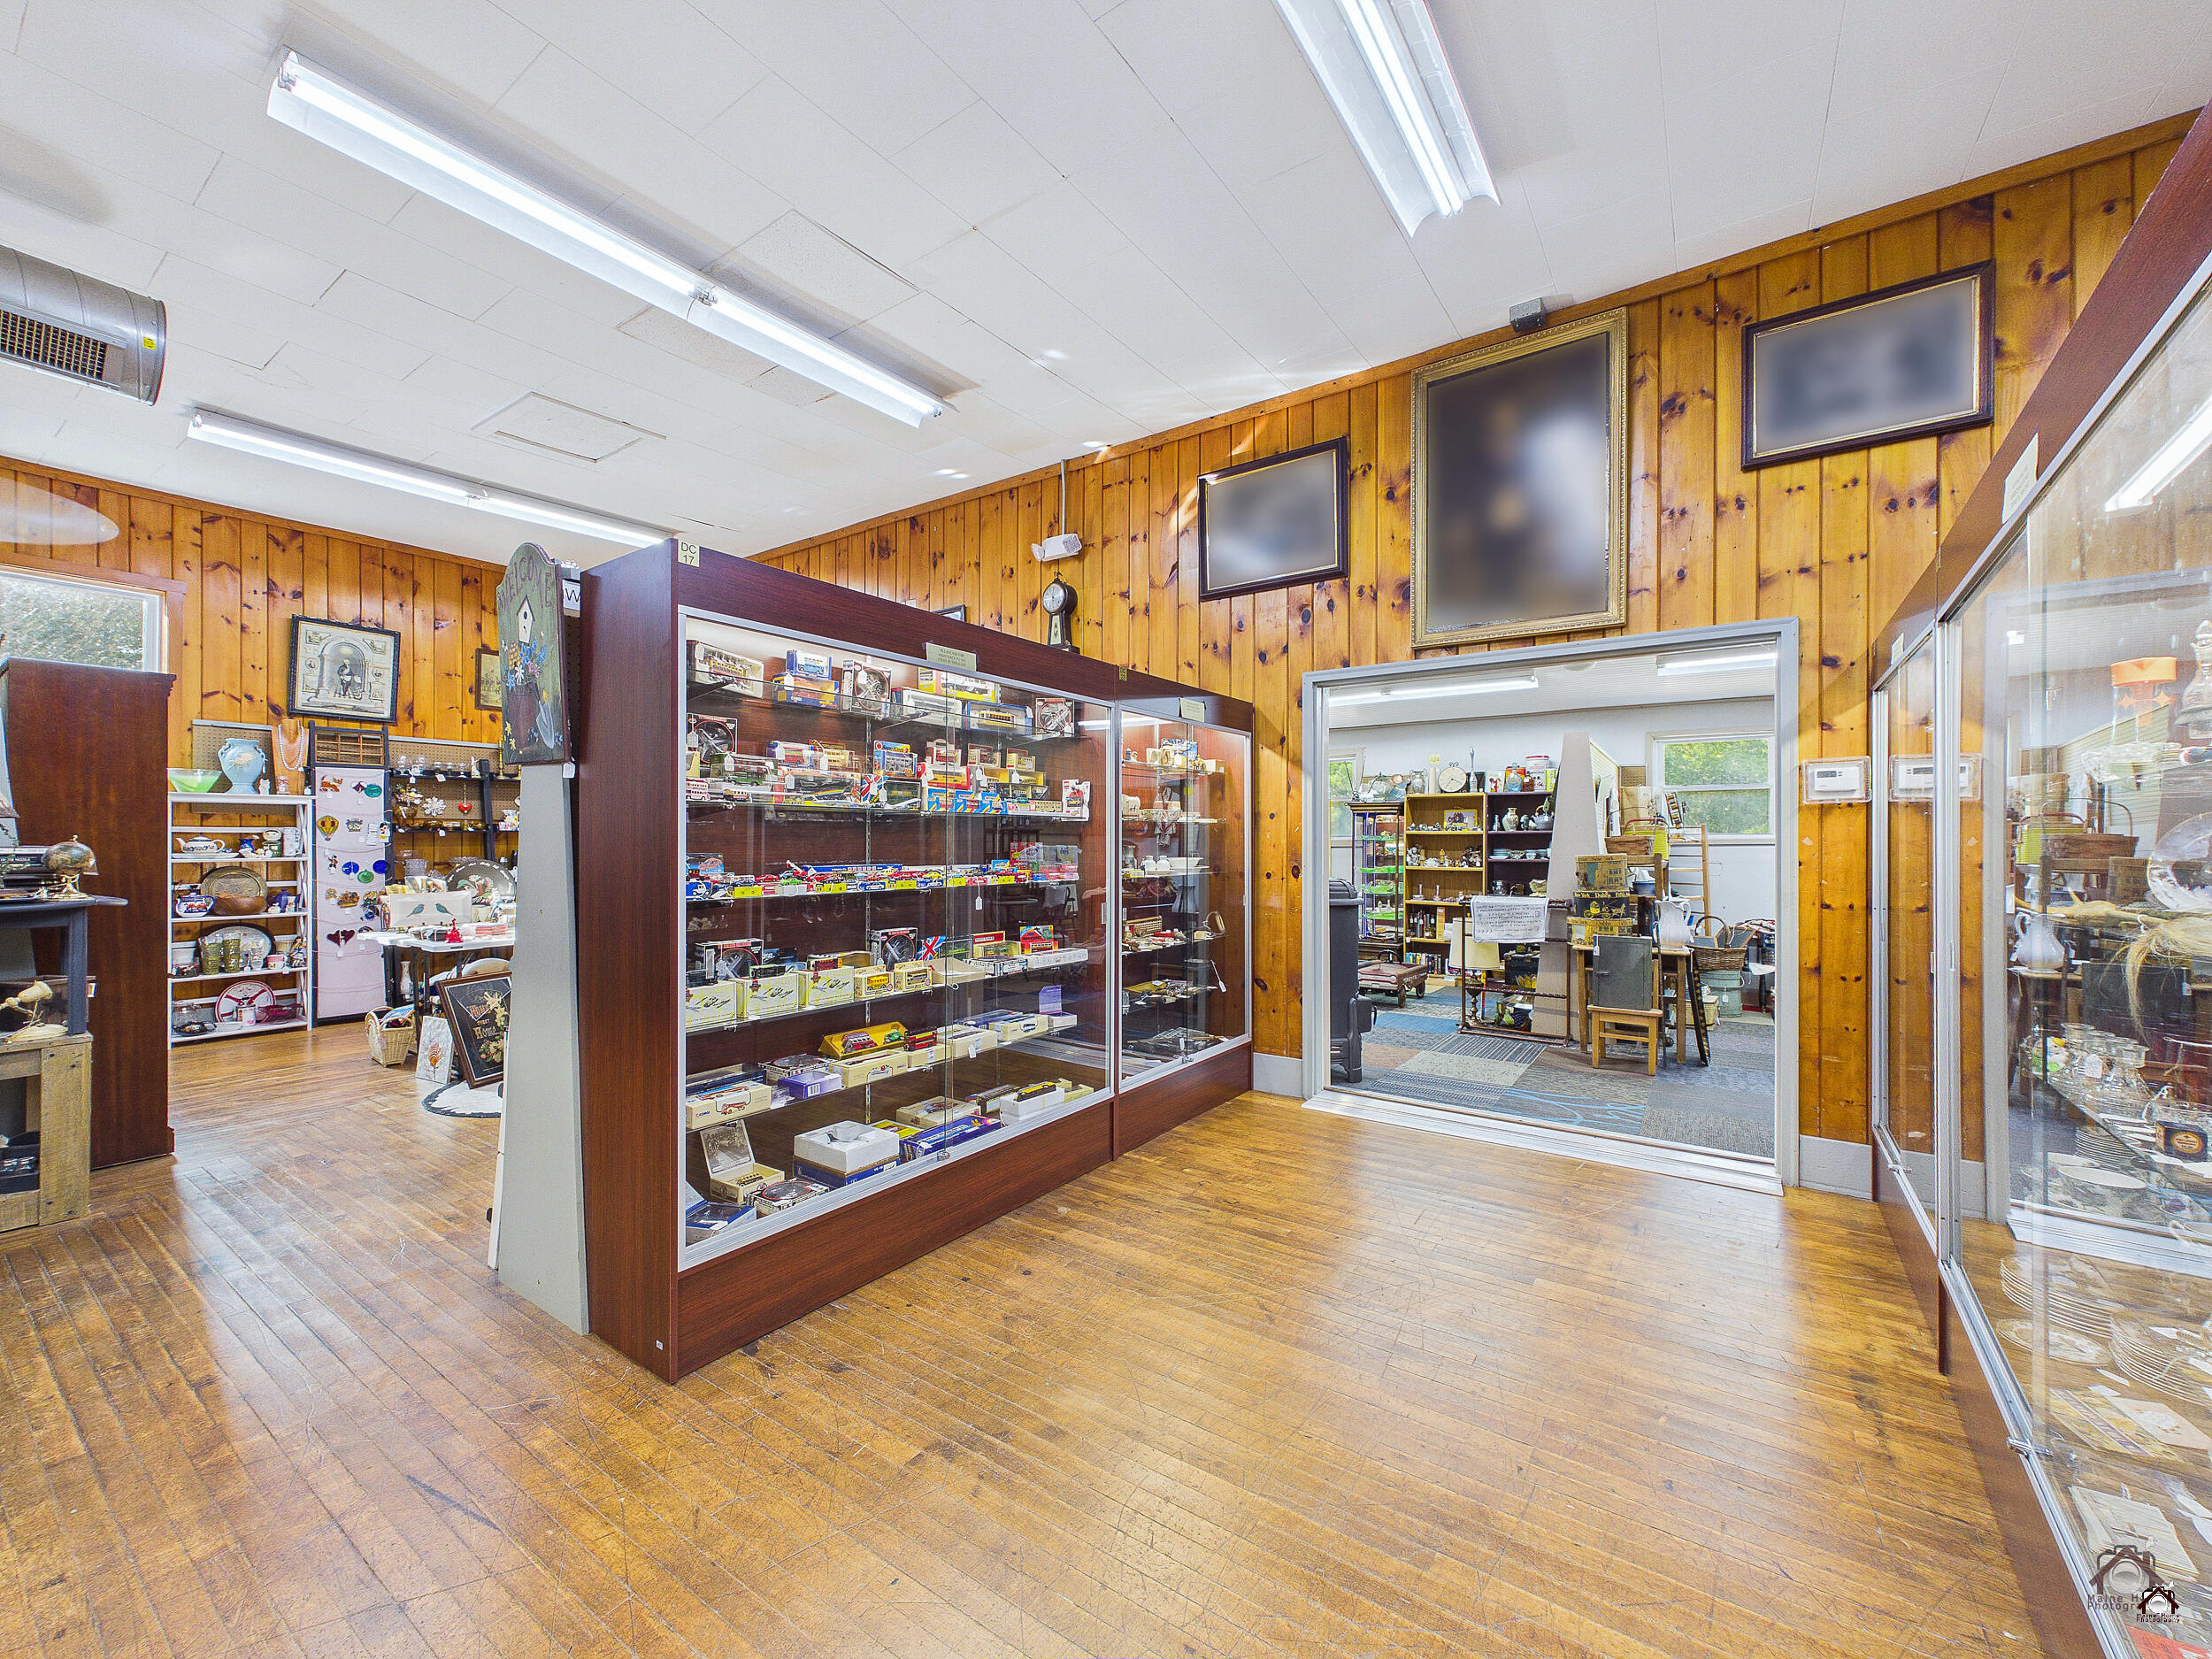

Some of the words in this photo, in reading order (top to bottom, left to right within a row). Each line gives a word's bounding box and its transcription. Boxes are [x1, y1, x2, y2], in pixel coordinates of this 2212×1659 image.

[681, 541, 696, 554] DC
[683, 555, 695, 565] 17
[497, 556, 553, 612] WELCOME
